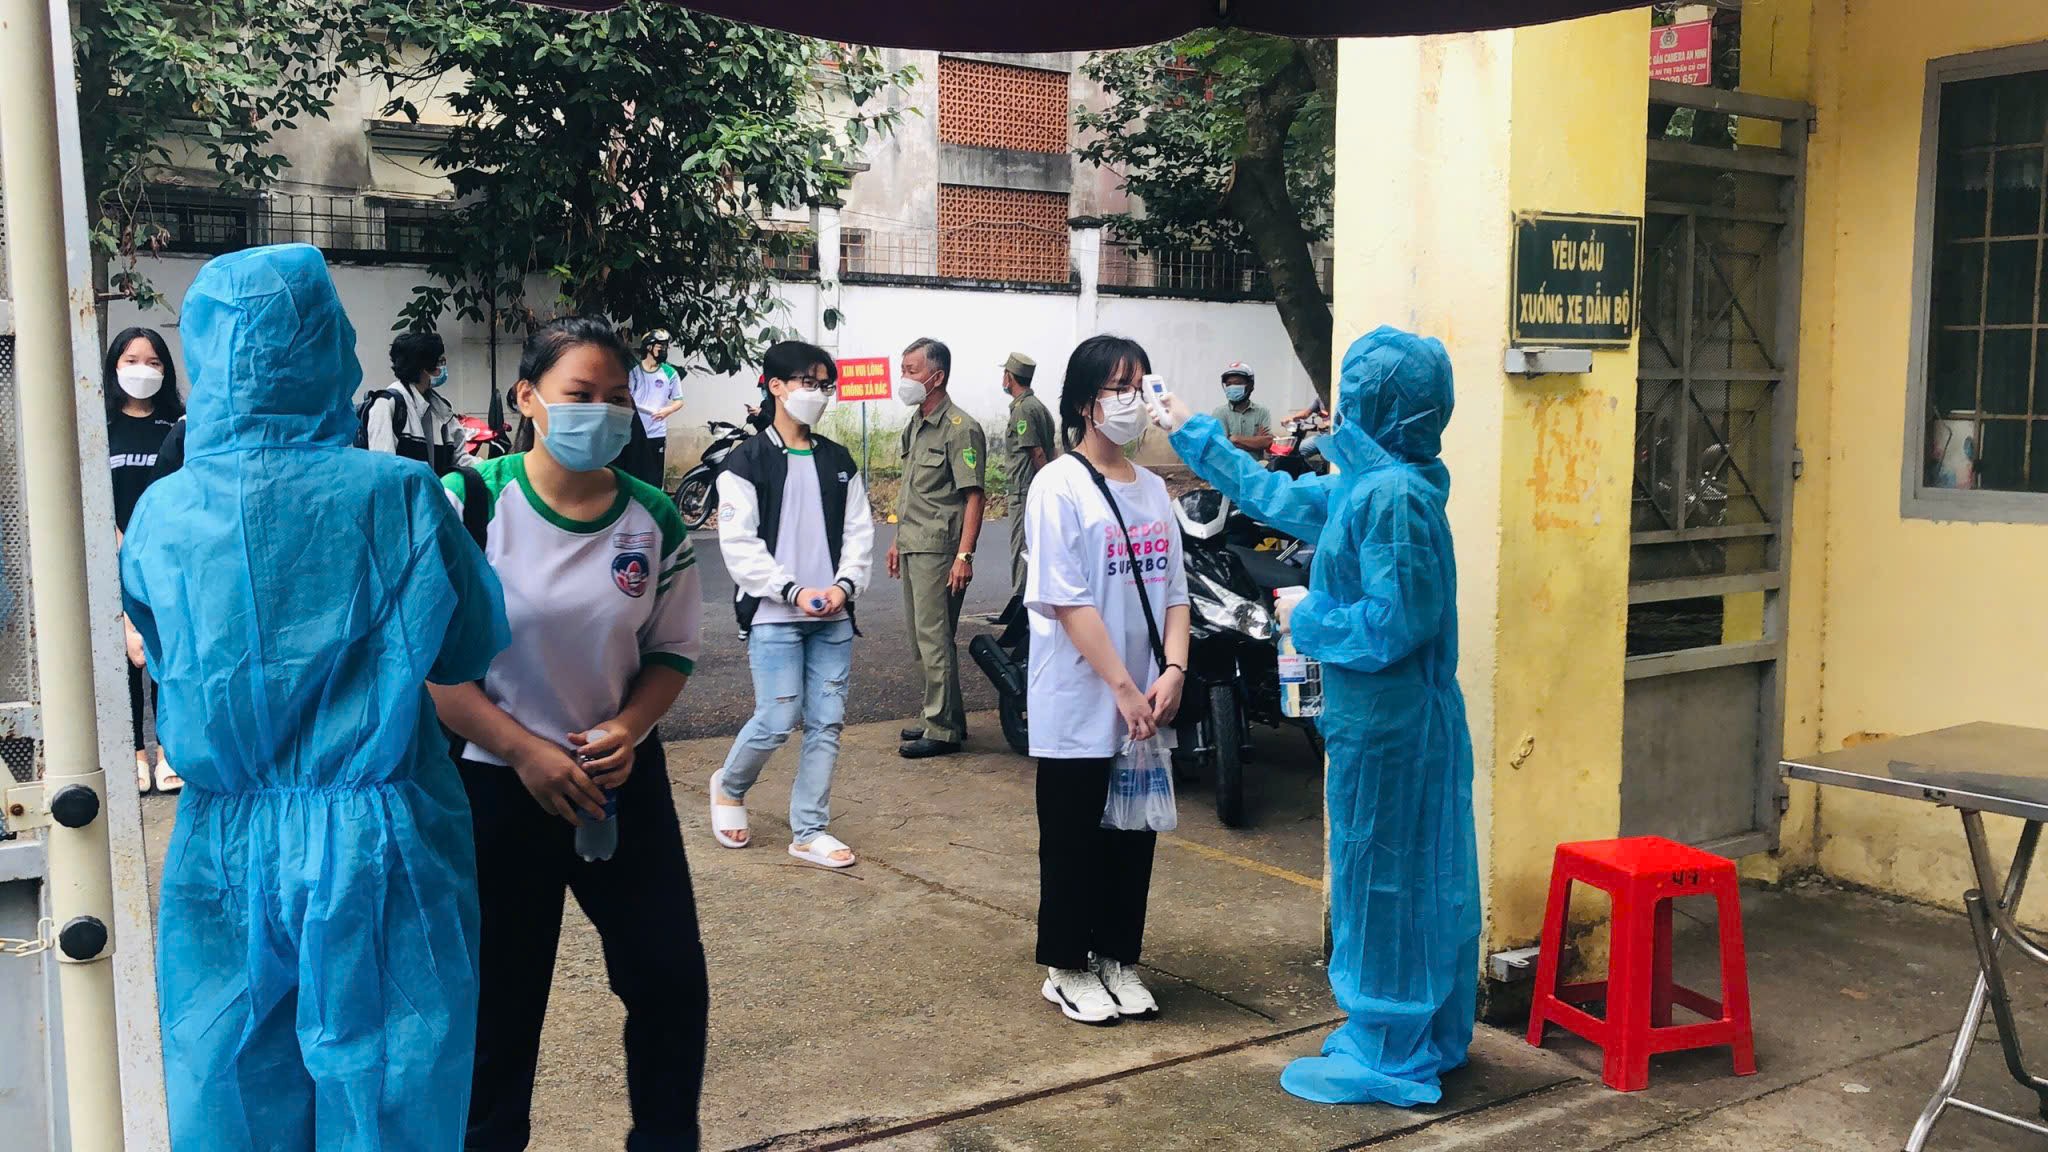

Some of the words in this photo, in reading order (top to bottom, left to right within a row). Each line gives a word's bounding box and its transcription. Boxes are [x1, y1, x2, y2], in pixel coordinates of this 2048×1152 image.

[1682, 72, 1699, 84] 657
[1552, 233, 1577, 270] YÊU
[1520, 281, 1563, 324] XUỐNG
[1566, 295, 1583, 324] XE
[1613, 289, 1630, 334] BỘ
